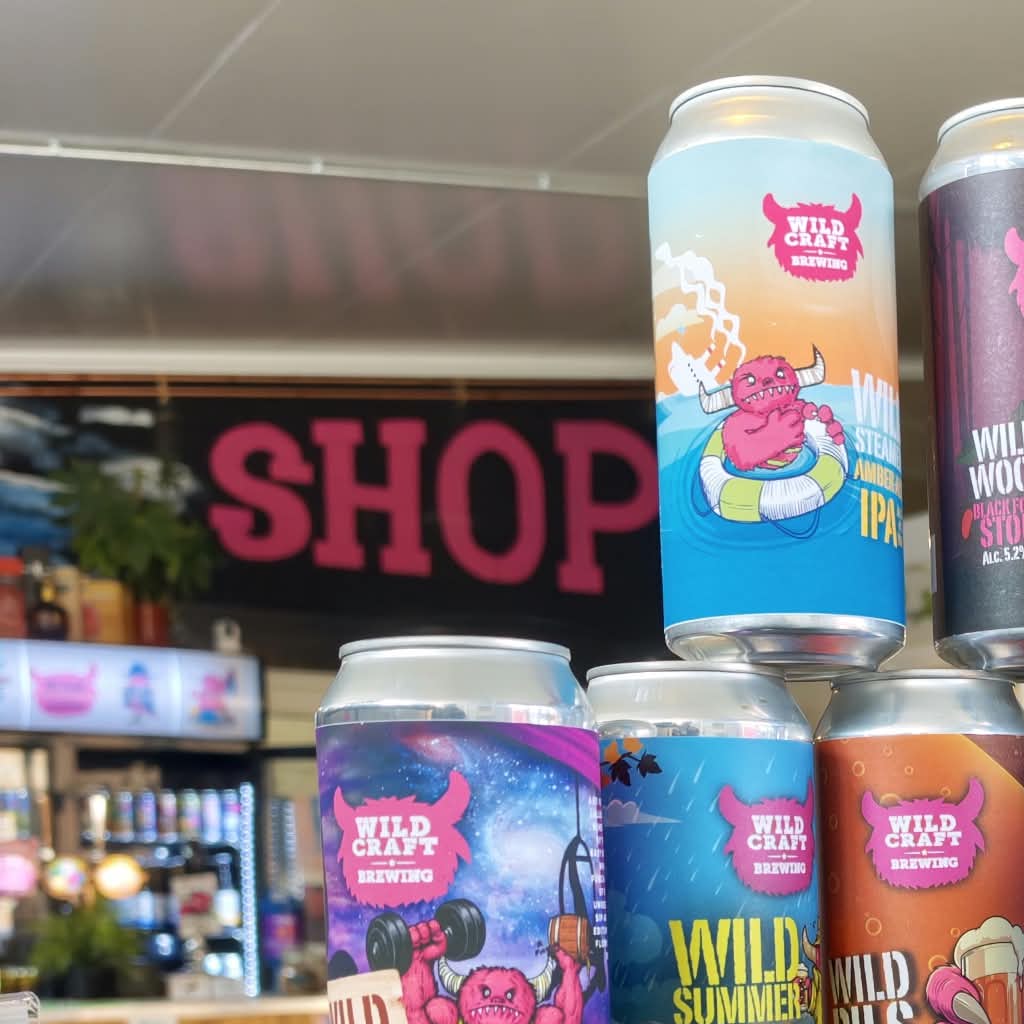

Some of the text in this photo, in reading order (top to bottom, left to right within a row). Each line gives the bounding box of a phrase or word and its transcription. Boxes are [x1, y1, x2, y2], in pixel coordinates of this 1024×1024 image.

[786, 216, 845, 236] WILD
[784, 232, 849, 251] CRAFT
[791, 256, 848, 270] BREWING
[209, 417, 660, 596] SHOP
[972, 501, 1011, 520] BLACK
[860, 487, 897, 548] IPA
[355, 815, 431, 838] WILD
[752, 815, 804, 835] WILD
[889, 814, 957, 833] WILD
[352, 837, 438, 857] CRAFT
[747, 834, 807, 851] CRAFT
[884, 831, 962, 848] CRAFT
[753, 862, 807, 875] BREWING
[890, 857, 959, 870] BREWING
[358, 869, 433, 884] BREWING
[668, 917, 800, 986] WILD
[829, 950, 910, 1004] WILD
